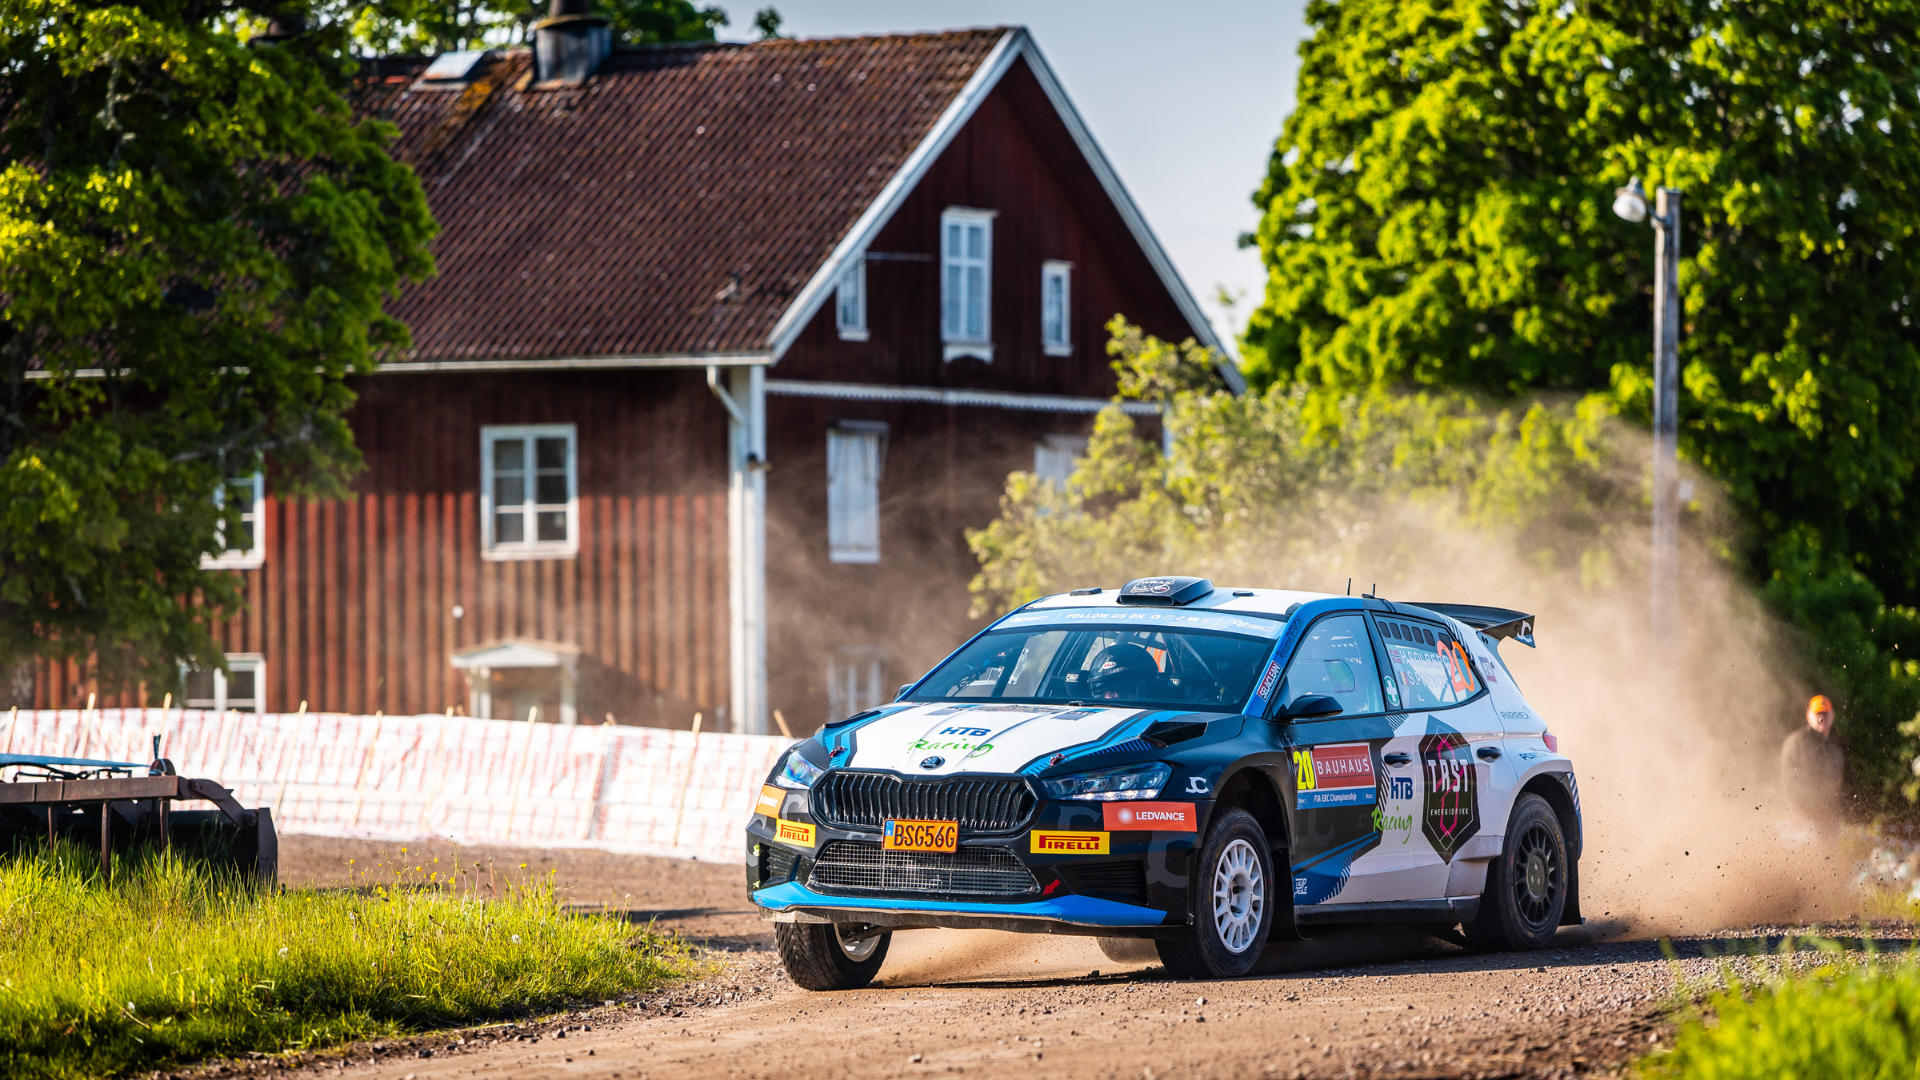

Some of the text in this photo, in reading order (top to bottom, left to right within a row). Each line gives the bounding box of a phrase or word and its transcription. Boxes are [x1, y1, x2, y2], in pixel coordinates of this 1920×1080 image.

[1437, 640, 1475, 693] 20
[1259, 662, 1281, 699] SELACLEAN
[1500, 711, 1531, 720] AIRREX
[939, 726, 992, 737] HTB
[907, 738, 994, 758] Racing
[1294, 750, 1315, 790] 20
[1317, 758, 1370, 775] BAUHAUS
[1313, 792, 1357, 803] FIA ERC Championship
[1391, 776, 1413, 800] HTB
[1136, 811, 1185, 821] LEDVANCE
[1430, 808, 1469, 816] ENERGIDRIKK
[779, 823, 810, 842] PIRELLI
[1371, 805, 1413, 844] Racing
[893, 824, 956, 848] BSG56G
[1038, 835, 1100, 850] PIRELLI
